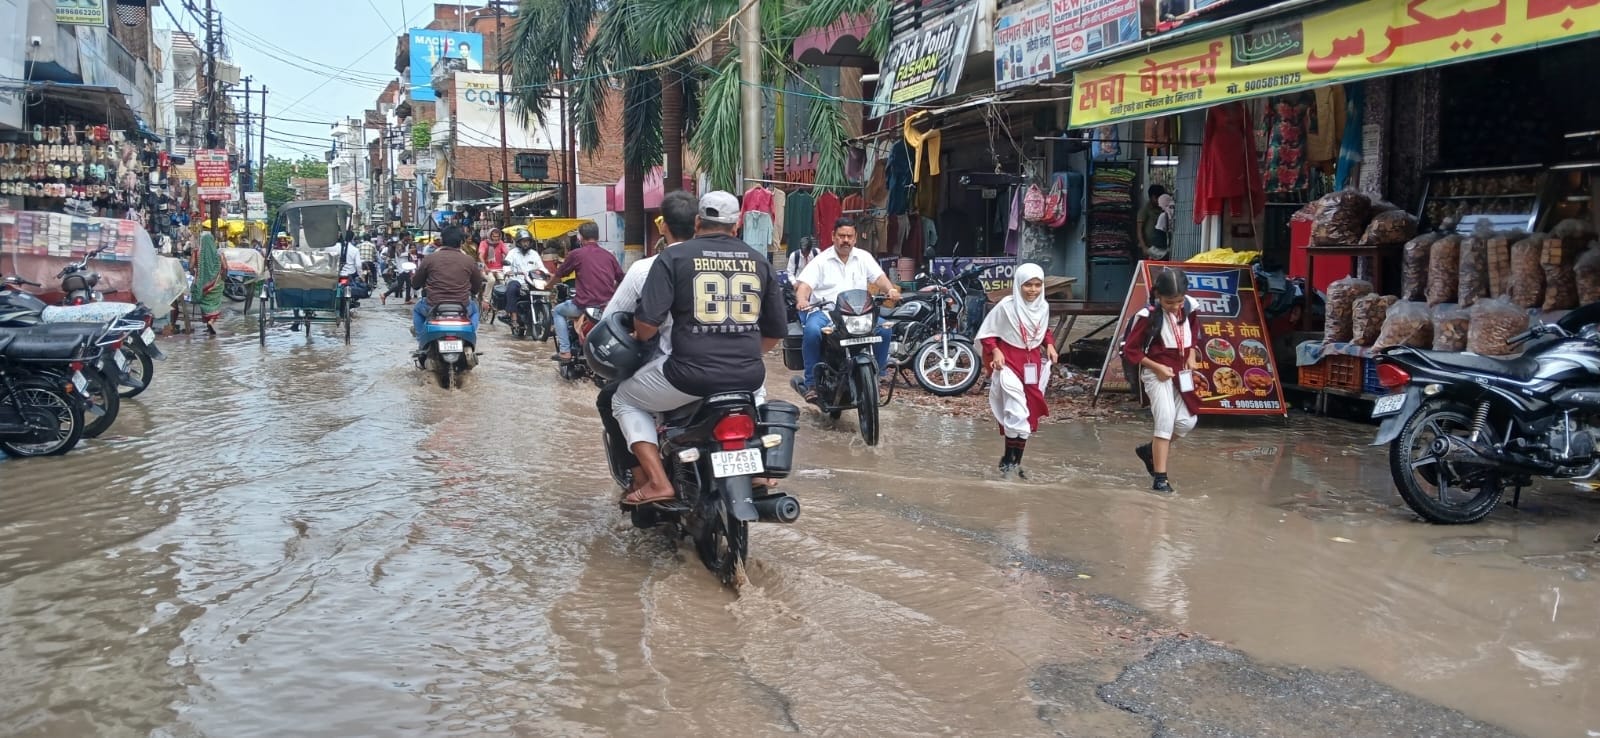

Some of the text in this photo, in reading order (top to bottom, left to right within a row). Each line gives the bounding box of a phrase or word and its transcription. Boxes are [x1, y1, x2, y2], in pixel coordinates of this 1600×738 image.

[897, 23, 954, 67] Pick Point
[897, 52, 939, 80] FASHION
[1079, 41, 1223, 111] सबा बेकर्स
[1244, 72, 1301, 92] 9005861675
[693, 258, 756, 272] BROOKLYN
[693, 272, 761, 324] 86
[984, 281, 1013, 290] ASHI
